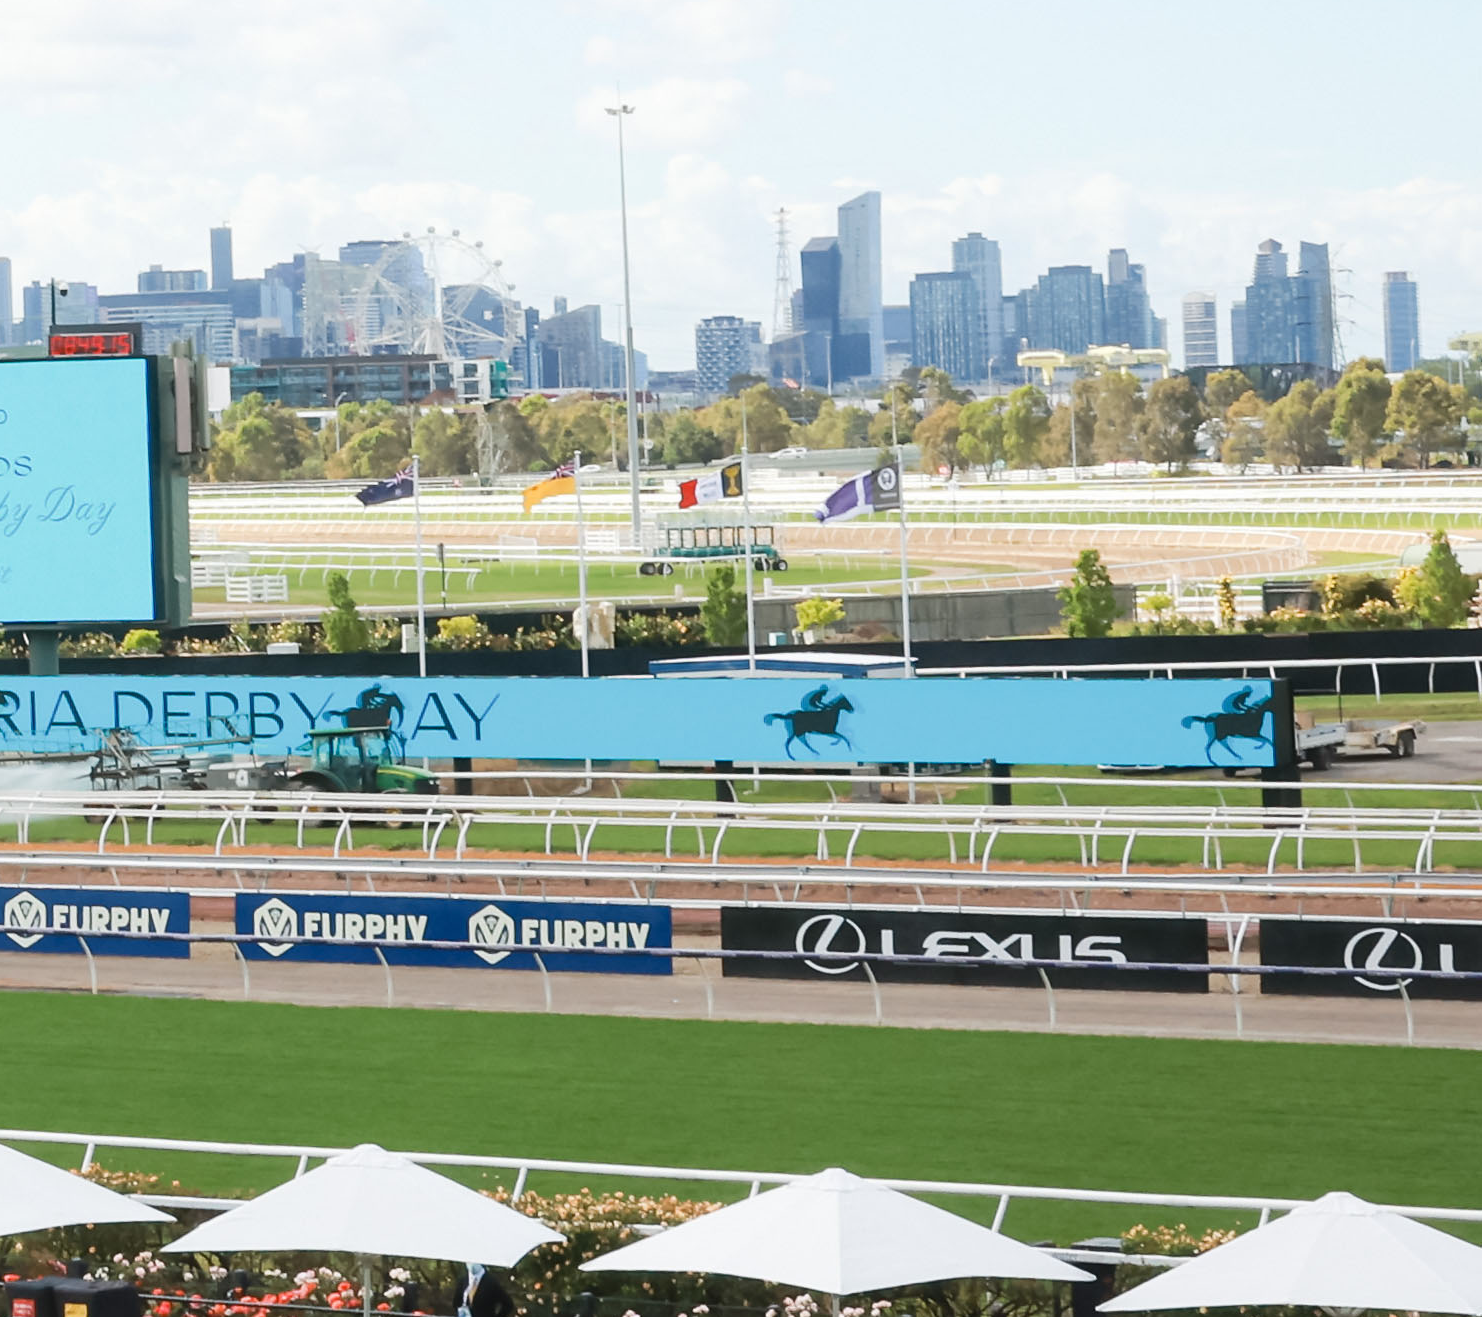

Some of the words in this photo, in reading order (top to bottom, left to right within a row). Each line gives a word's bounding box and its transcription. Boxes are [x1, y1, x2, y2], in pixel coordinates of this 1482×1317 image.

[36, 484, 117, 537] Day
[113, 690, 334, 739] DERBY
[52, 905, 169, 934] FURPHY
[304, 912, 427, 942] FURPHY
[521, 919, 649, 949] FURPHY
[881, 929, 1127, 964] LEXUS
